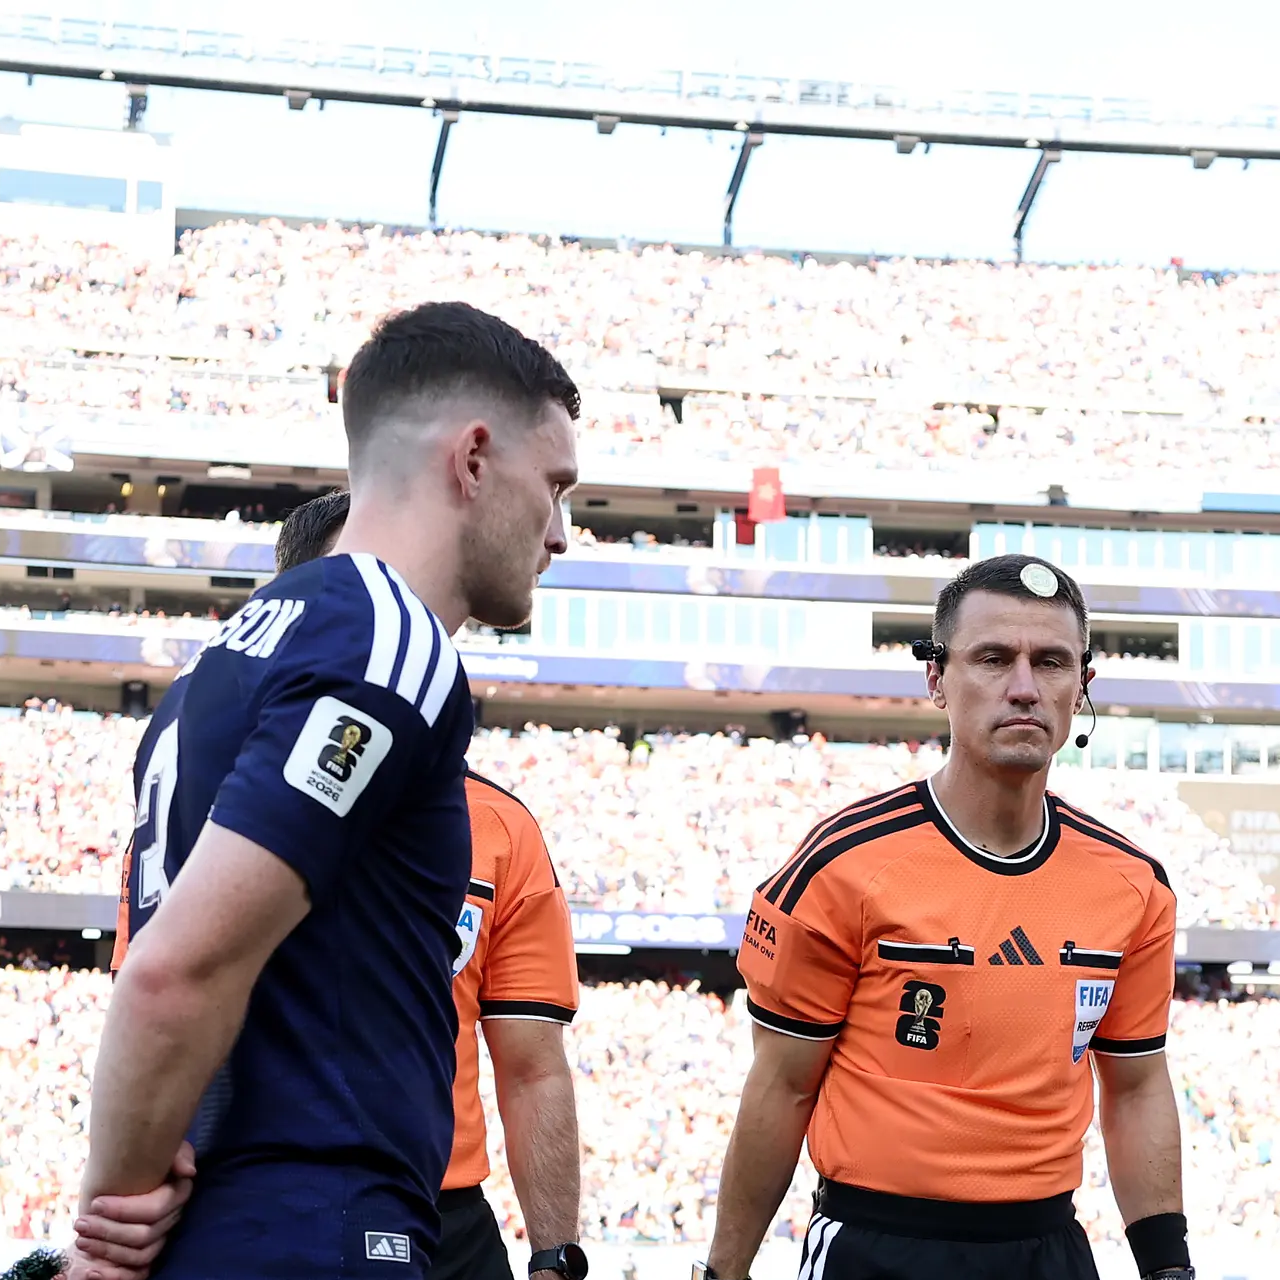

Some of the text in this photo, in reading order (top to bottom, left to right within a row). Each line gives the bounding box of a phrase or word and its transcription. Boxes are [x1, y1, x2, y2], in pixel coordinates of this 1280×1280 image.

[325, 760, 344, 777] FIFA
[306, 776, 340, 802] 2026
[570, 911, 726, 942] UP 2026
[746, 909, 777, 945] FIFA
[743, 932, 775, 960] TEAM ONE
[1080, 986, 1109, 1006] FIFA
[906, 1033, 927, 1044] FIFA
